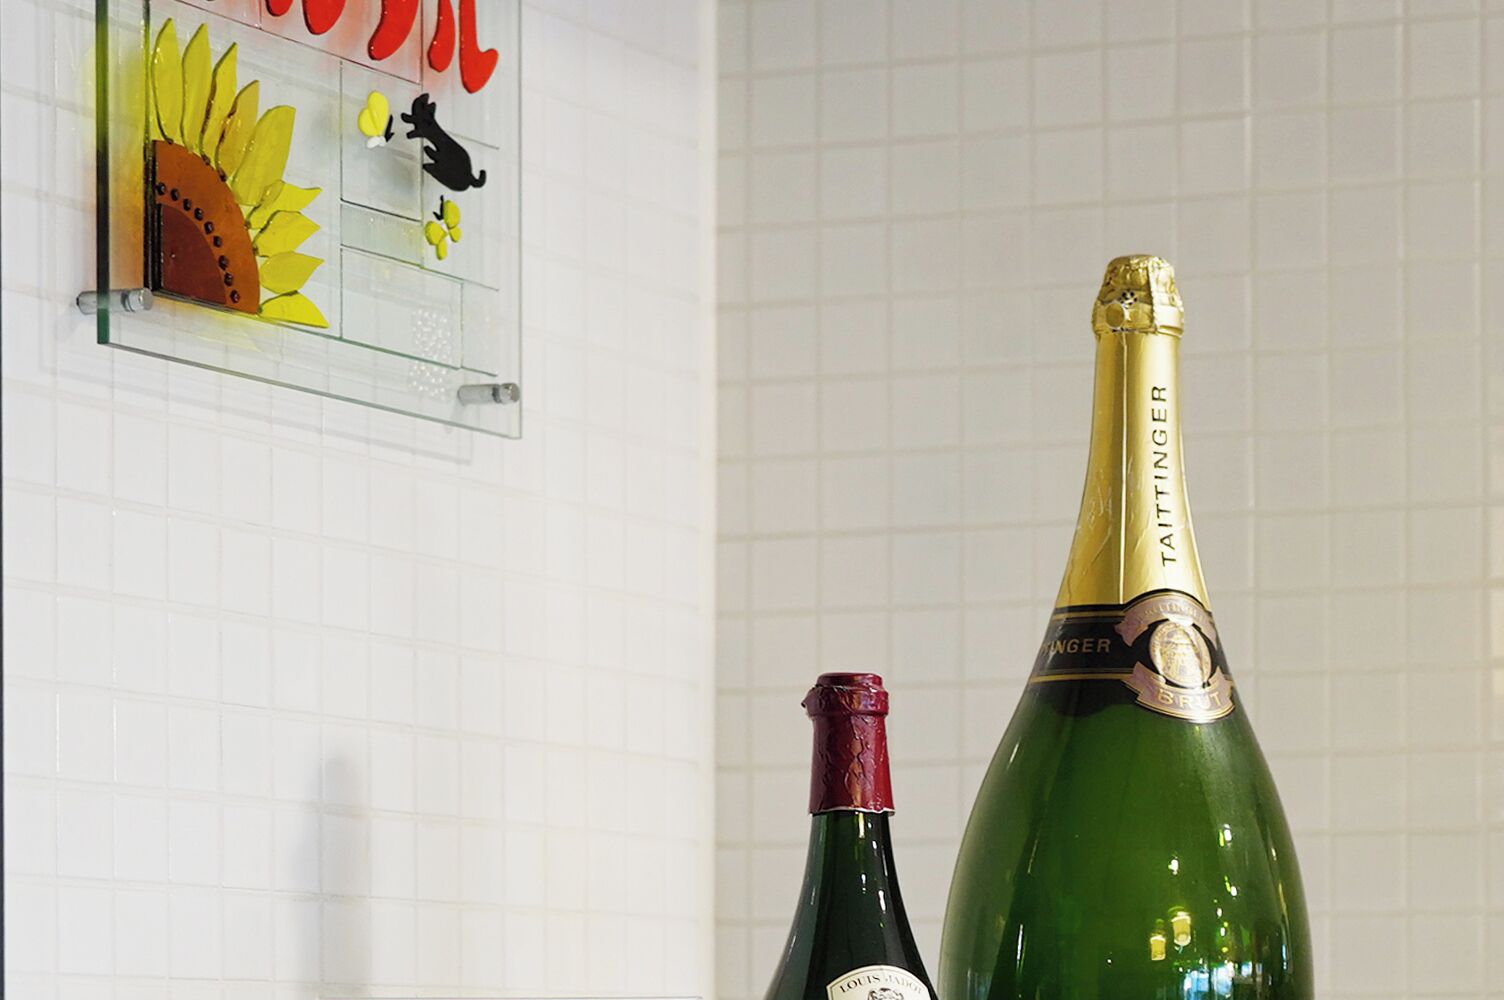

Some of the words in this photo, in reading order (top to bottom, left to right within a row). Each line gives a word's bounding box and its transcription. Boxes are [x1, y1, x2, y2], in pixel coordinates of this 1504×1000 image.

[1151, 385, 1177, 567] TAITTINGER
[1157, 689, 1221, 710] BRUT
[840, 975, 881, 994] LOUIS
